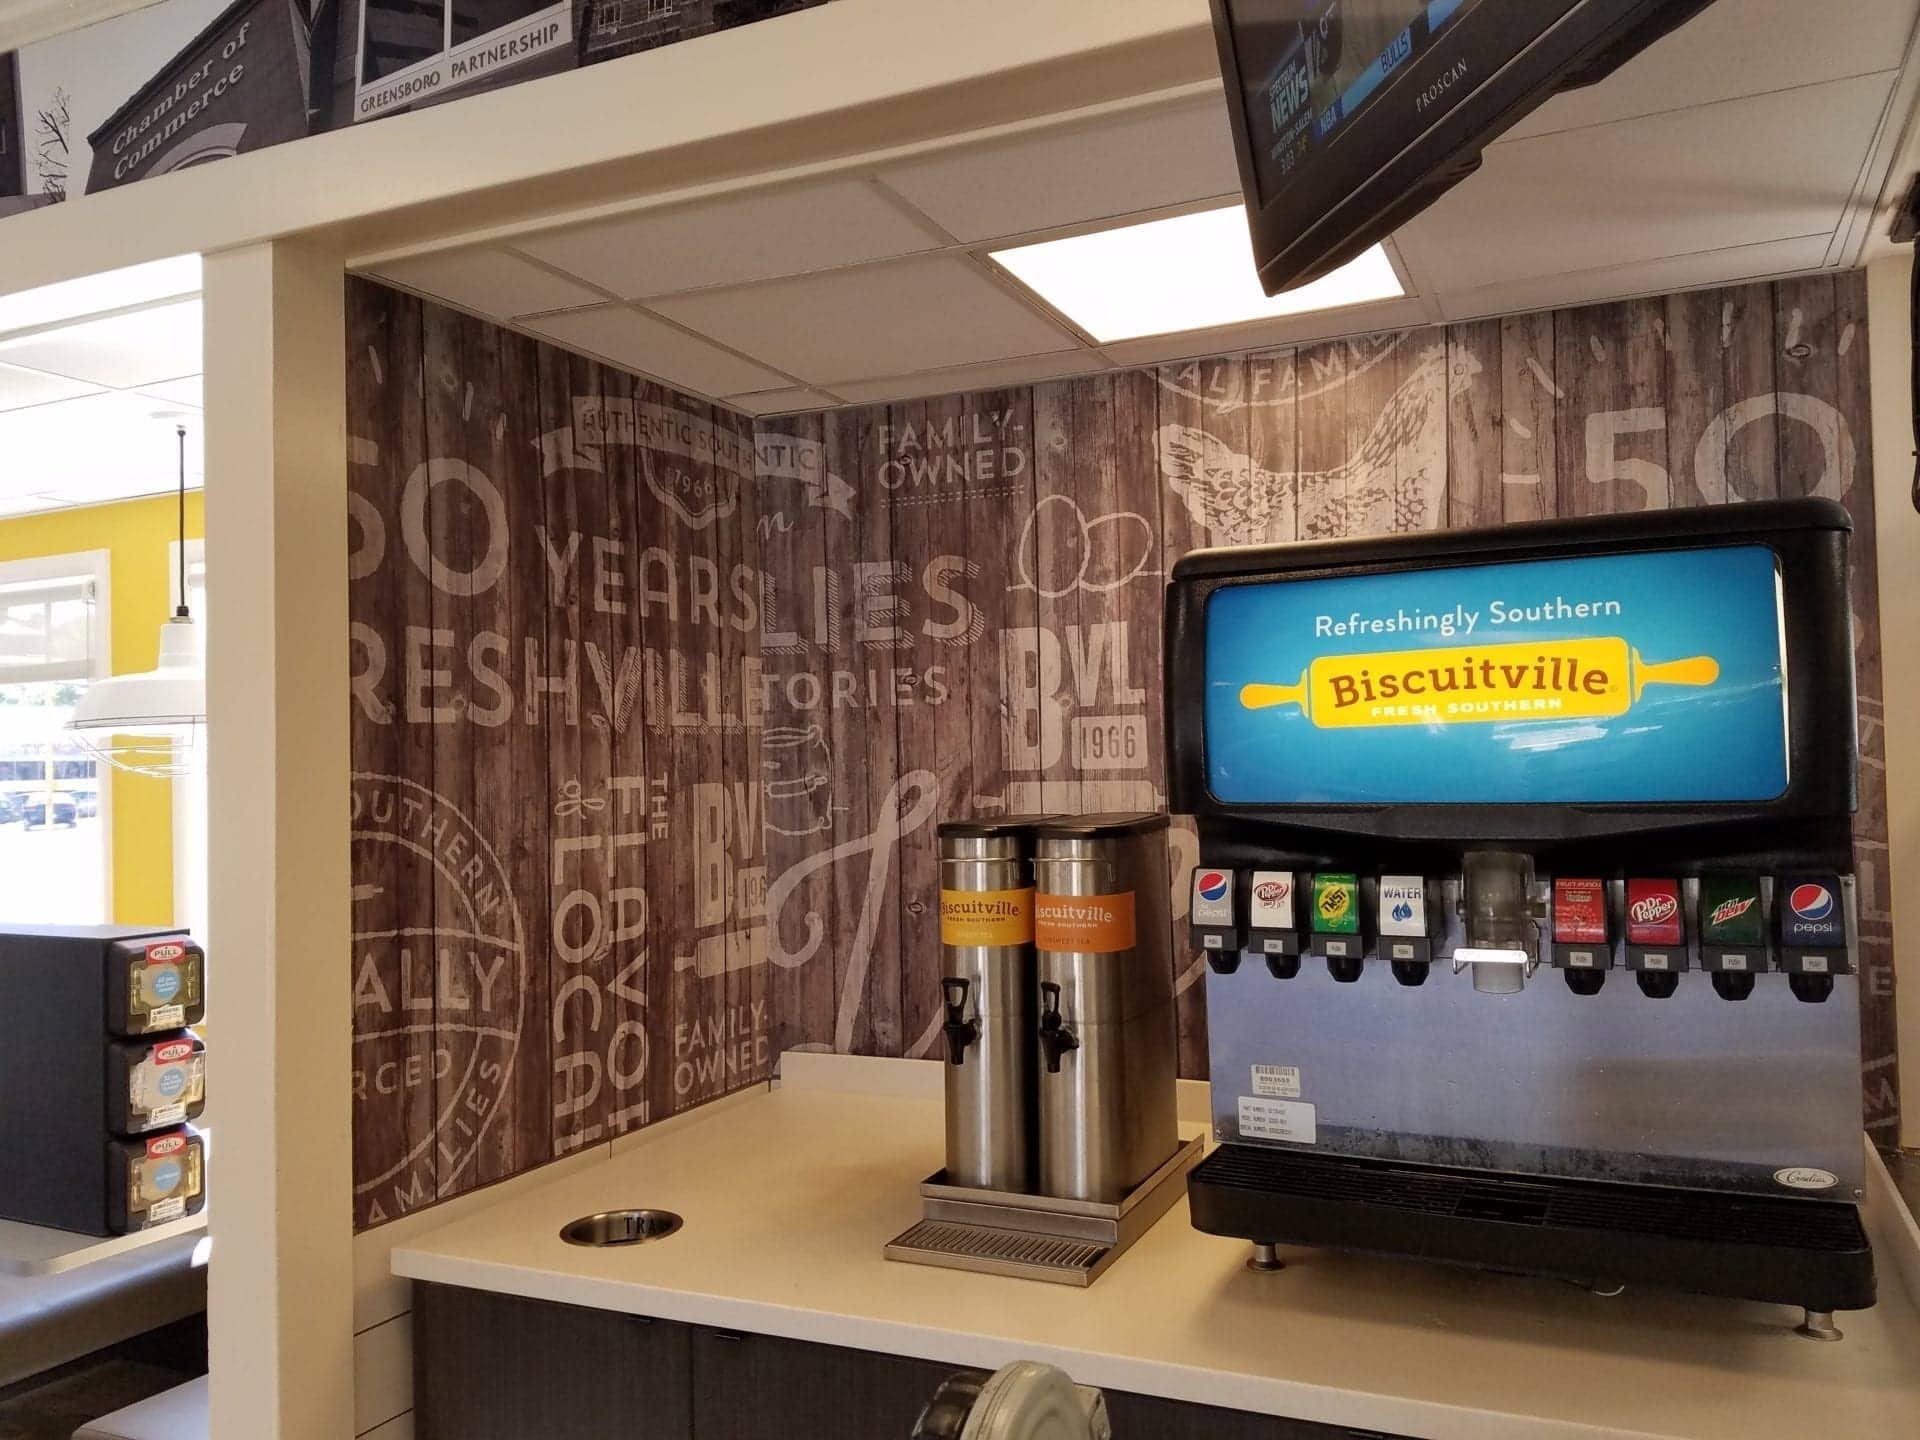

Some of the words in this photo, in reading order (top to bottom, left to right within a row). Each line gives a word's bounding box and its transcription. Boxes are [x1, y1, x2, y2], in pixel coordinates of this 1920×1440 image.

[360, 71, 440, 113] GREENSBORO
[451, 23, 559, 78] PARTNERSHIP
[1380, 31, 1410, 74] BULLS
[112, 59, 213, 155] Chamber
[222, 22, 250, 59] of
[1271, 64, 1309, 133] NEWS
[1416, 57, 1468, 112] PROSCAN
[114, 64, 244, 180] Commerce
[1320, 105, 1338, 136] NBA
[583, 408, 692, 446] AUTHENTIC
[878, 408, 1026, 455] FAMILY-
[878, 446, 1026, 490] OWNED
[1585, 391, 1856, 511] 50
[674, 468, 713, 498] 1966
[534, 525, 758, 633] YEARS
[1315, 604, 1480, 637] Refreshingly
[1489, 597, 1621, 624] Southern
[999, 621, 1146, 771] BVL
[1328, 655, 1609, 709] Biscuitville
[1370, 704, 1438, 718] FRESH
[1447, 698, 1562, 714] SOUTHERN
[1081, 724, 1138, 761] 1966
[651, 772, 668, 841] THE
[1384, 888, 1421, 899] WATER
[1635, 900, 1673, 922] Pepper
[1646, 897, 1662, 909] Dr
[1793, 921, 1832, 935] pepsi
[154, 948, 178, 957] PULL
[161, 1047, 186, 1057] PULL
[674, 1036, 768, 1095] OWNED
[155, 1141, 180, 1151] PULL
